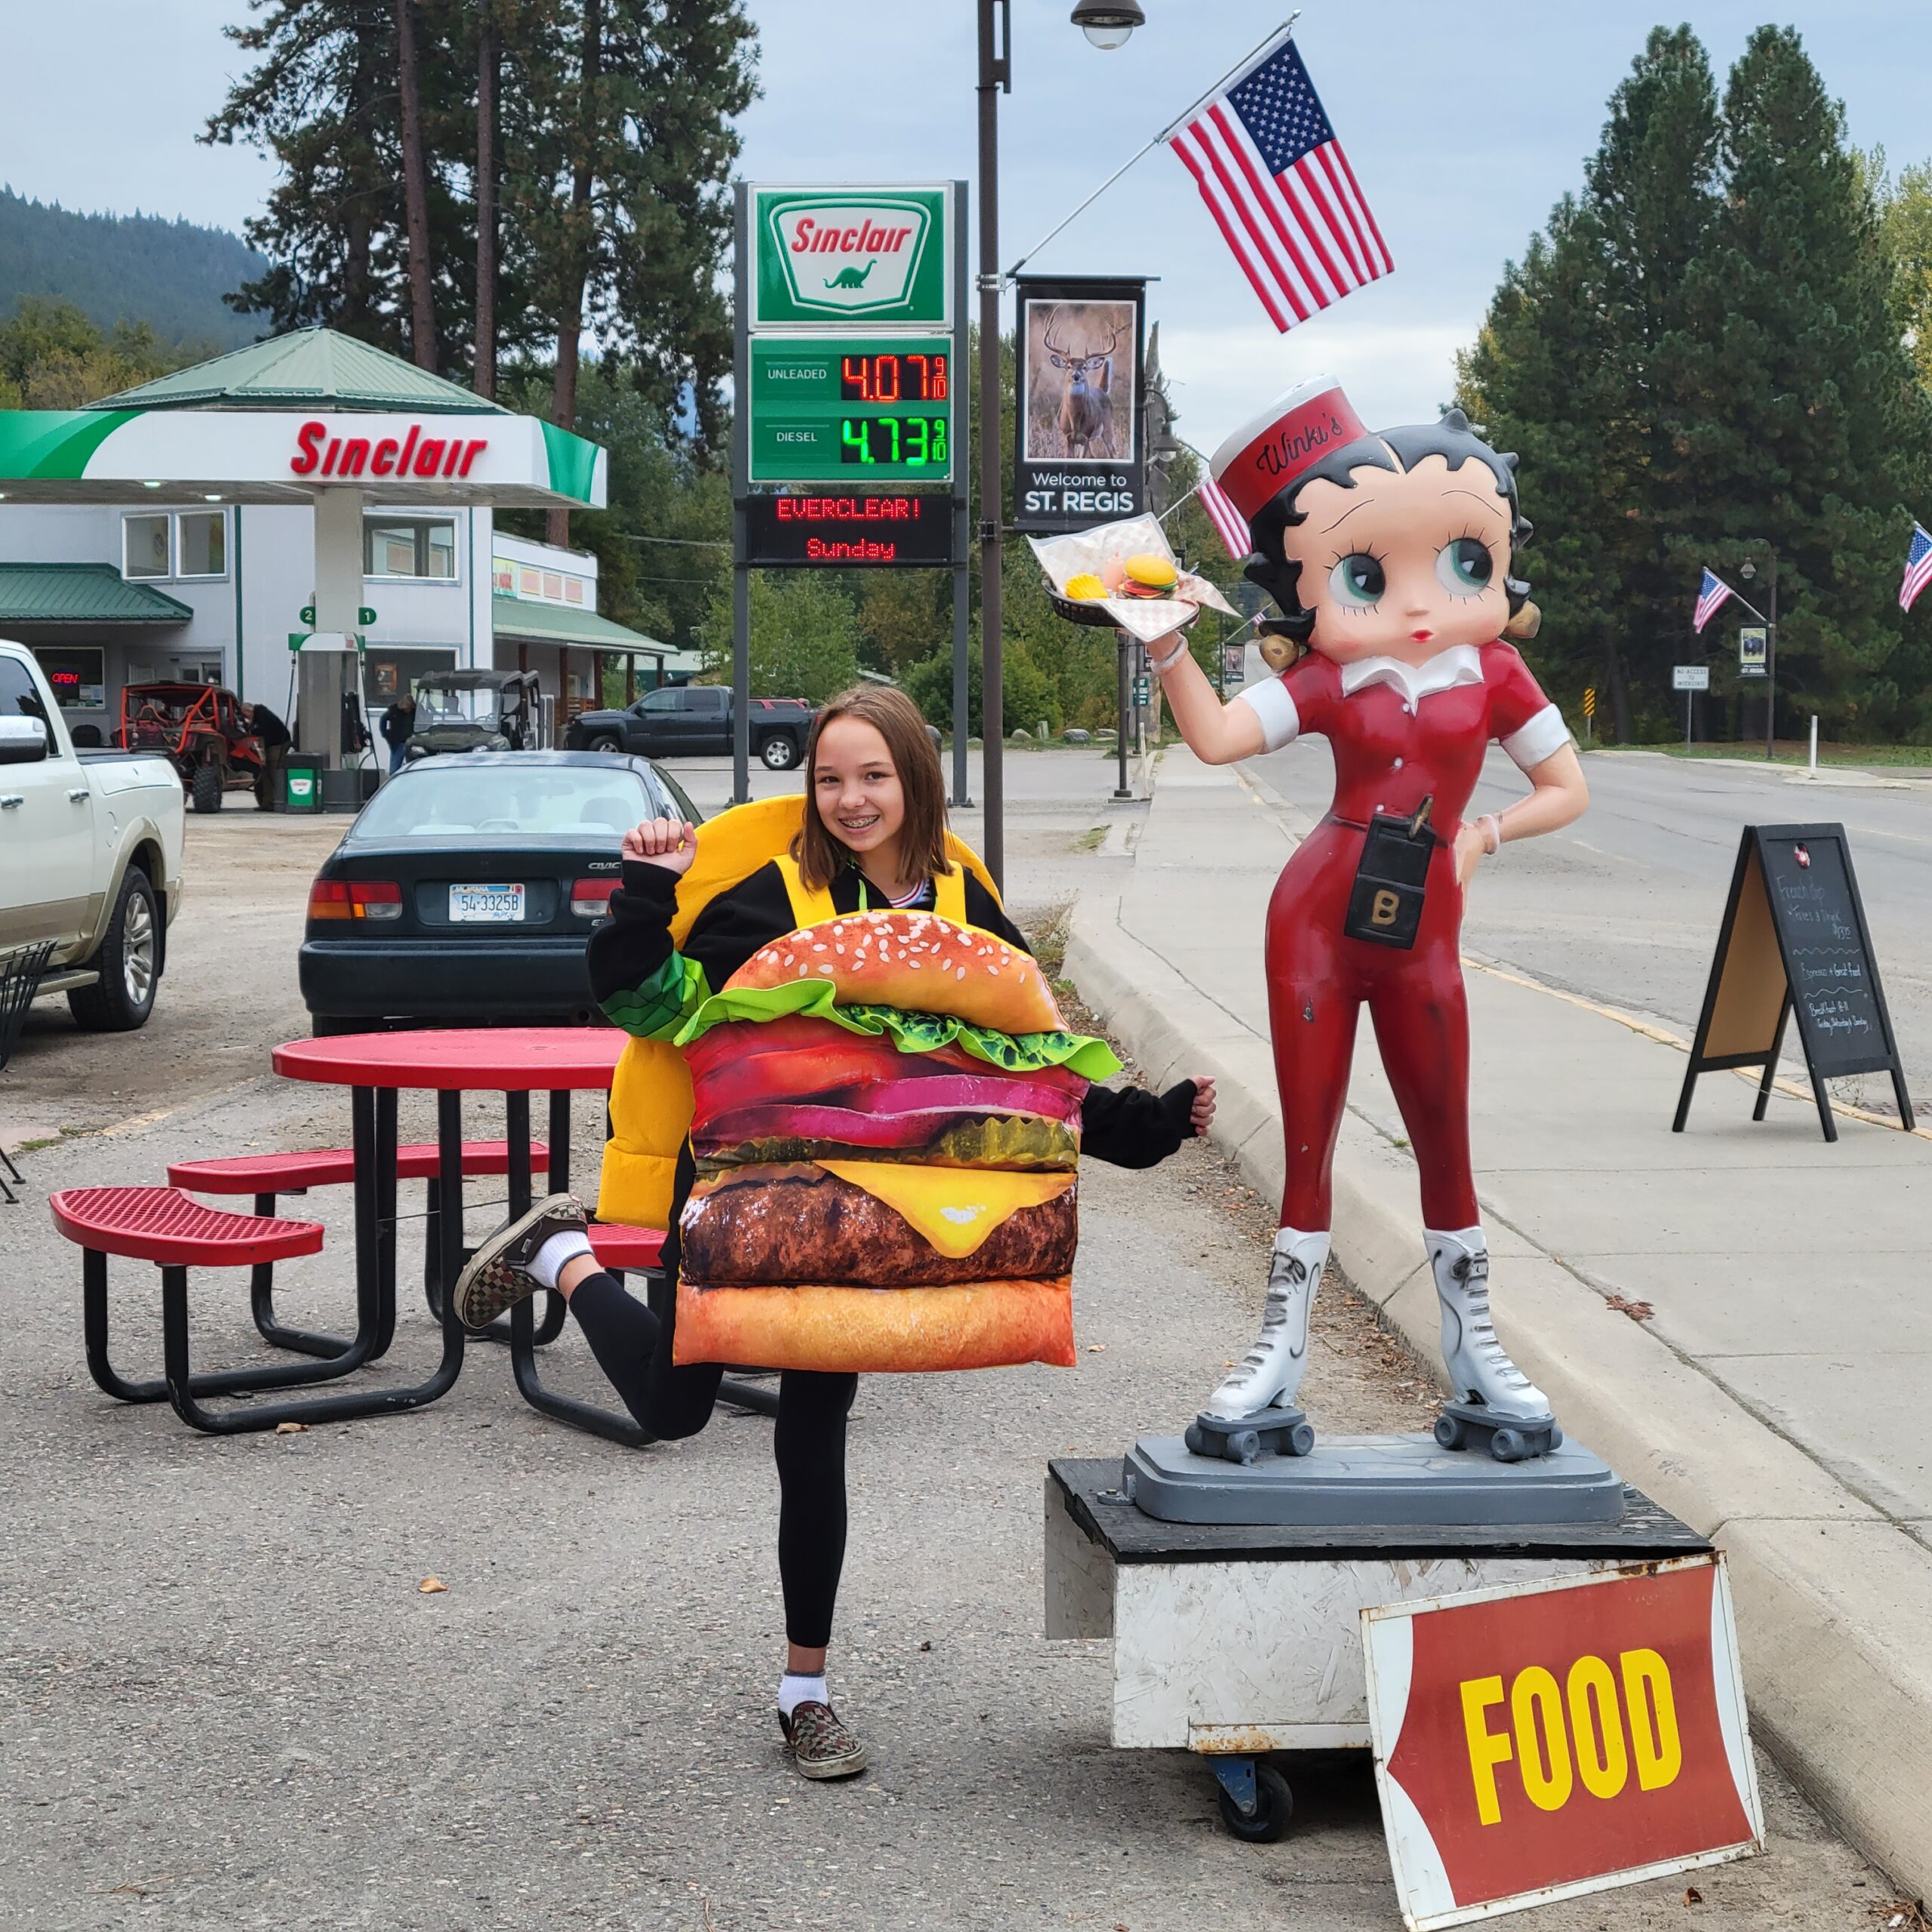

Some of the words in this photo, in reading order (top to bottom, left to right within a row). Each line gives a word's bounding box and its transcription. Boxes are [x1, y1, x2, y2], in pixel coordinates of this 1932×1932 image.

[792, 217, 912, 253] Sinclair
[768, 369, 827, 380] UNLEADED
[776, 432, 818, 442] DIESEL
[1256, 412, 1343, 475] Winki's
[290, 420, 488, 478] Sinclair
[1032, 472, 1106, 487] Welcome
[1110, 474, 1128, 487] to
[777, 498, 920, 519] EVERCLEAR!
[1025, 491, 1057, 512] ST.
[1063, 491, 1134, 512] REGIS
[808, 537, 896, 560] Sunday
[304, 609, 313, 620] 2
[364, 611, 371, 622] 1
[51, 672, 79, 685] OPEN
[588, 862, 622, 870] CIVIC
[1372, 889, 1400, 926] B
[1460, 1648, 1681, 1826] FOOD
